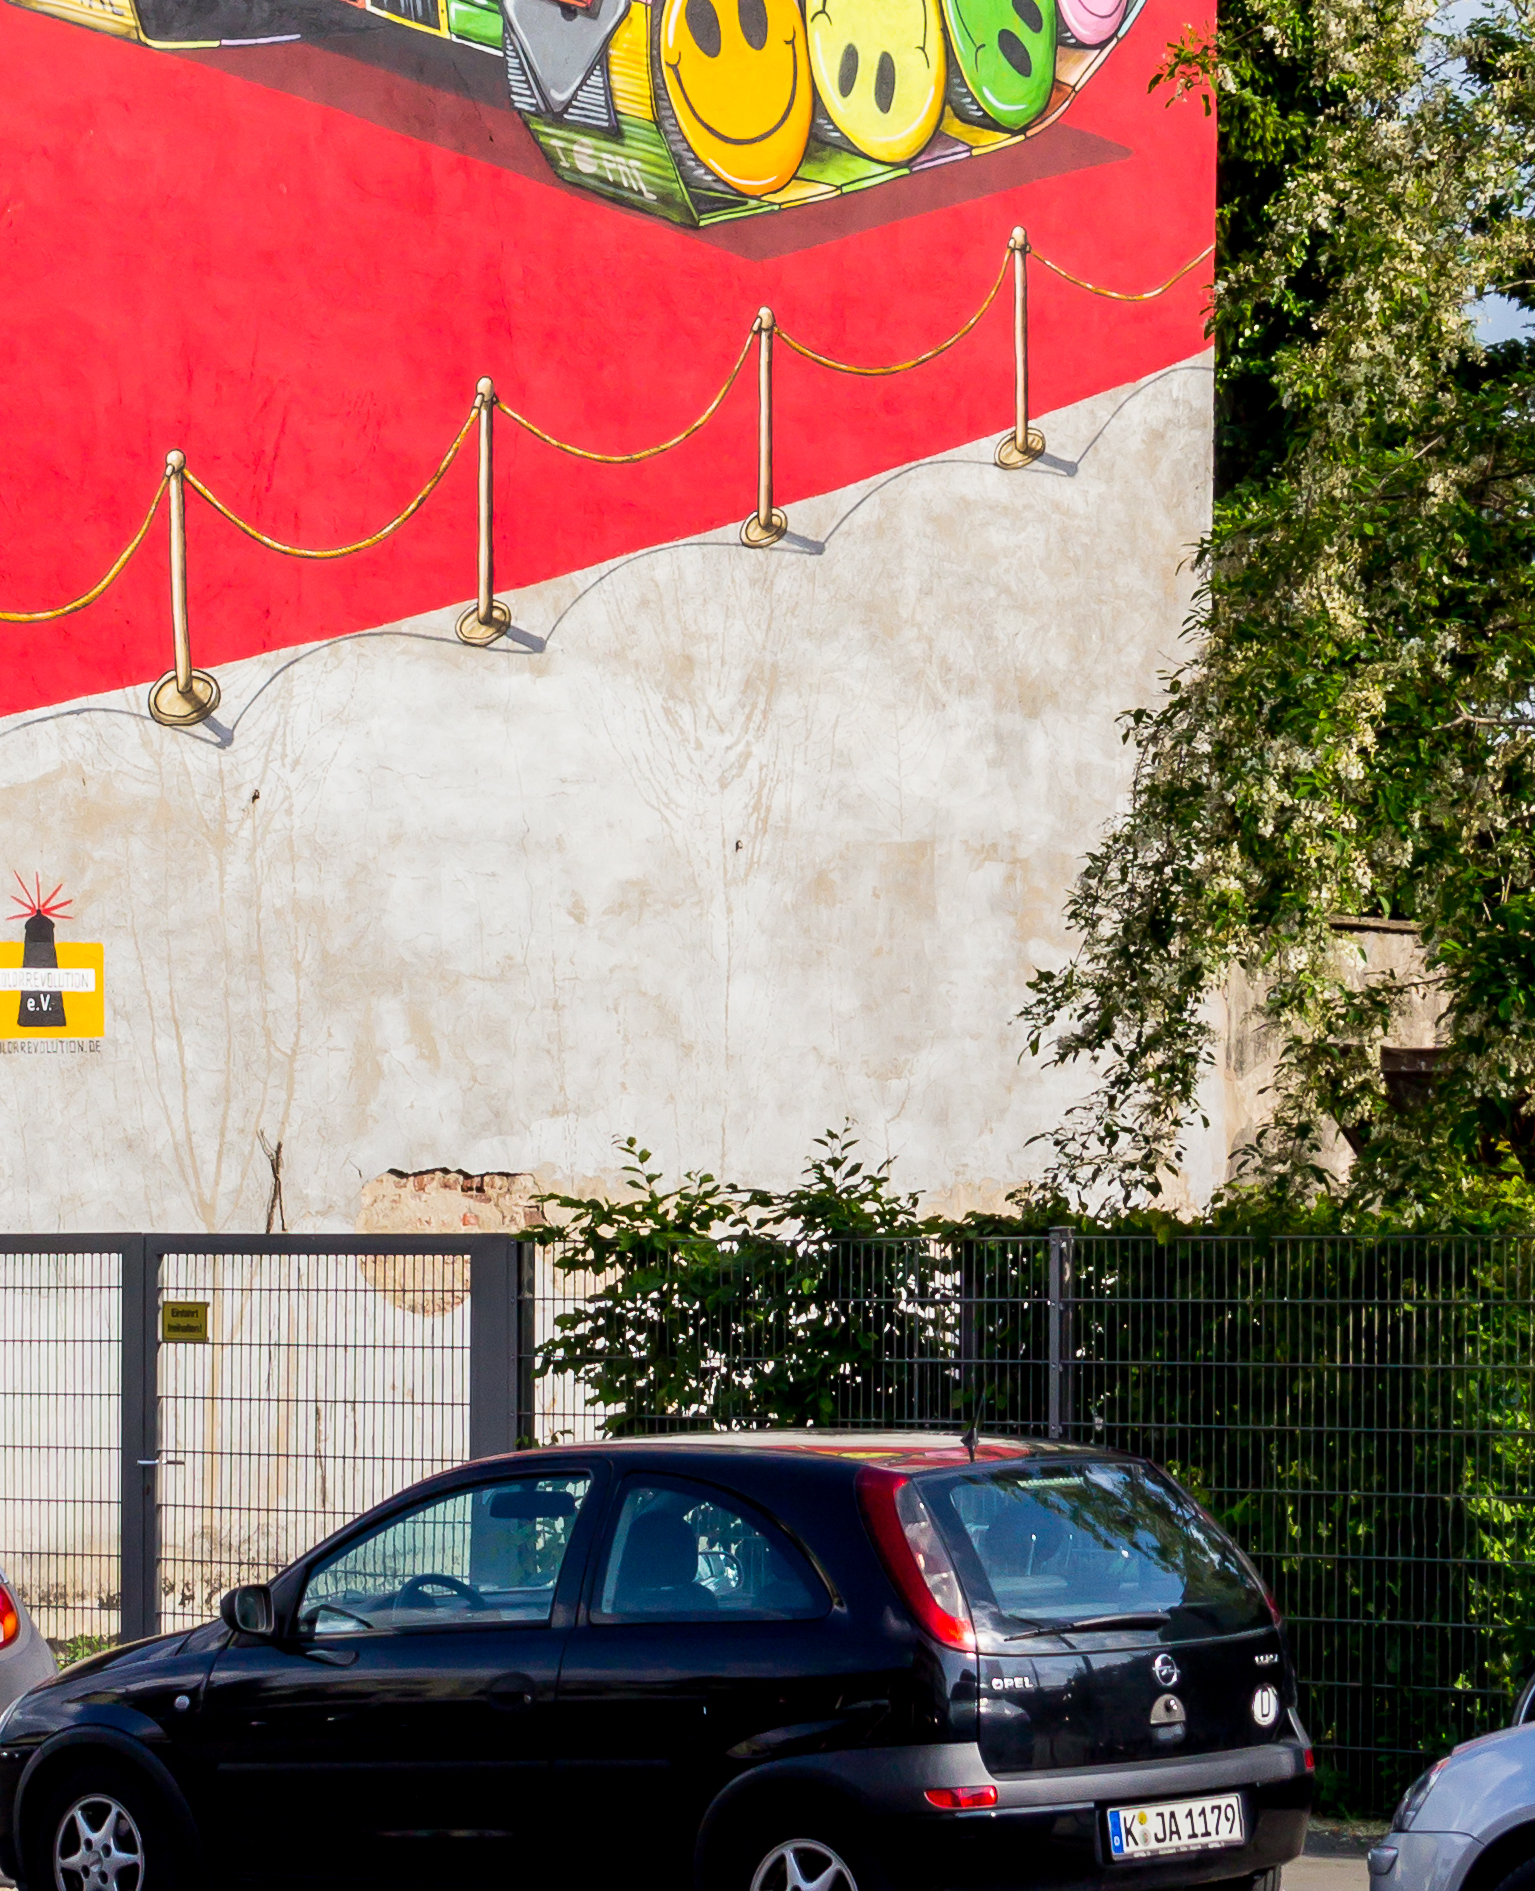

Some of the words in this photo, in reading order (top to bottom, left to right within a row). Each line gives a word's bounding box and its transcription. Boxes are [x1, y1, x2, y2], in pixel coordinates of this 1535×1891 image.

[26, 993, 53, 1011] e.V.
[991, 1675, 1034, 1690] OPEL
[1123, 1814, 1140, 1848] K
[1153, 1810, 1183, 1844] JA
[1185, 1803, 1236, 1840] 1179
